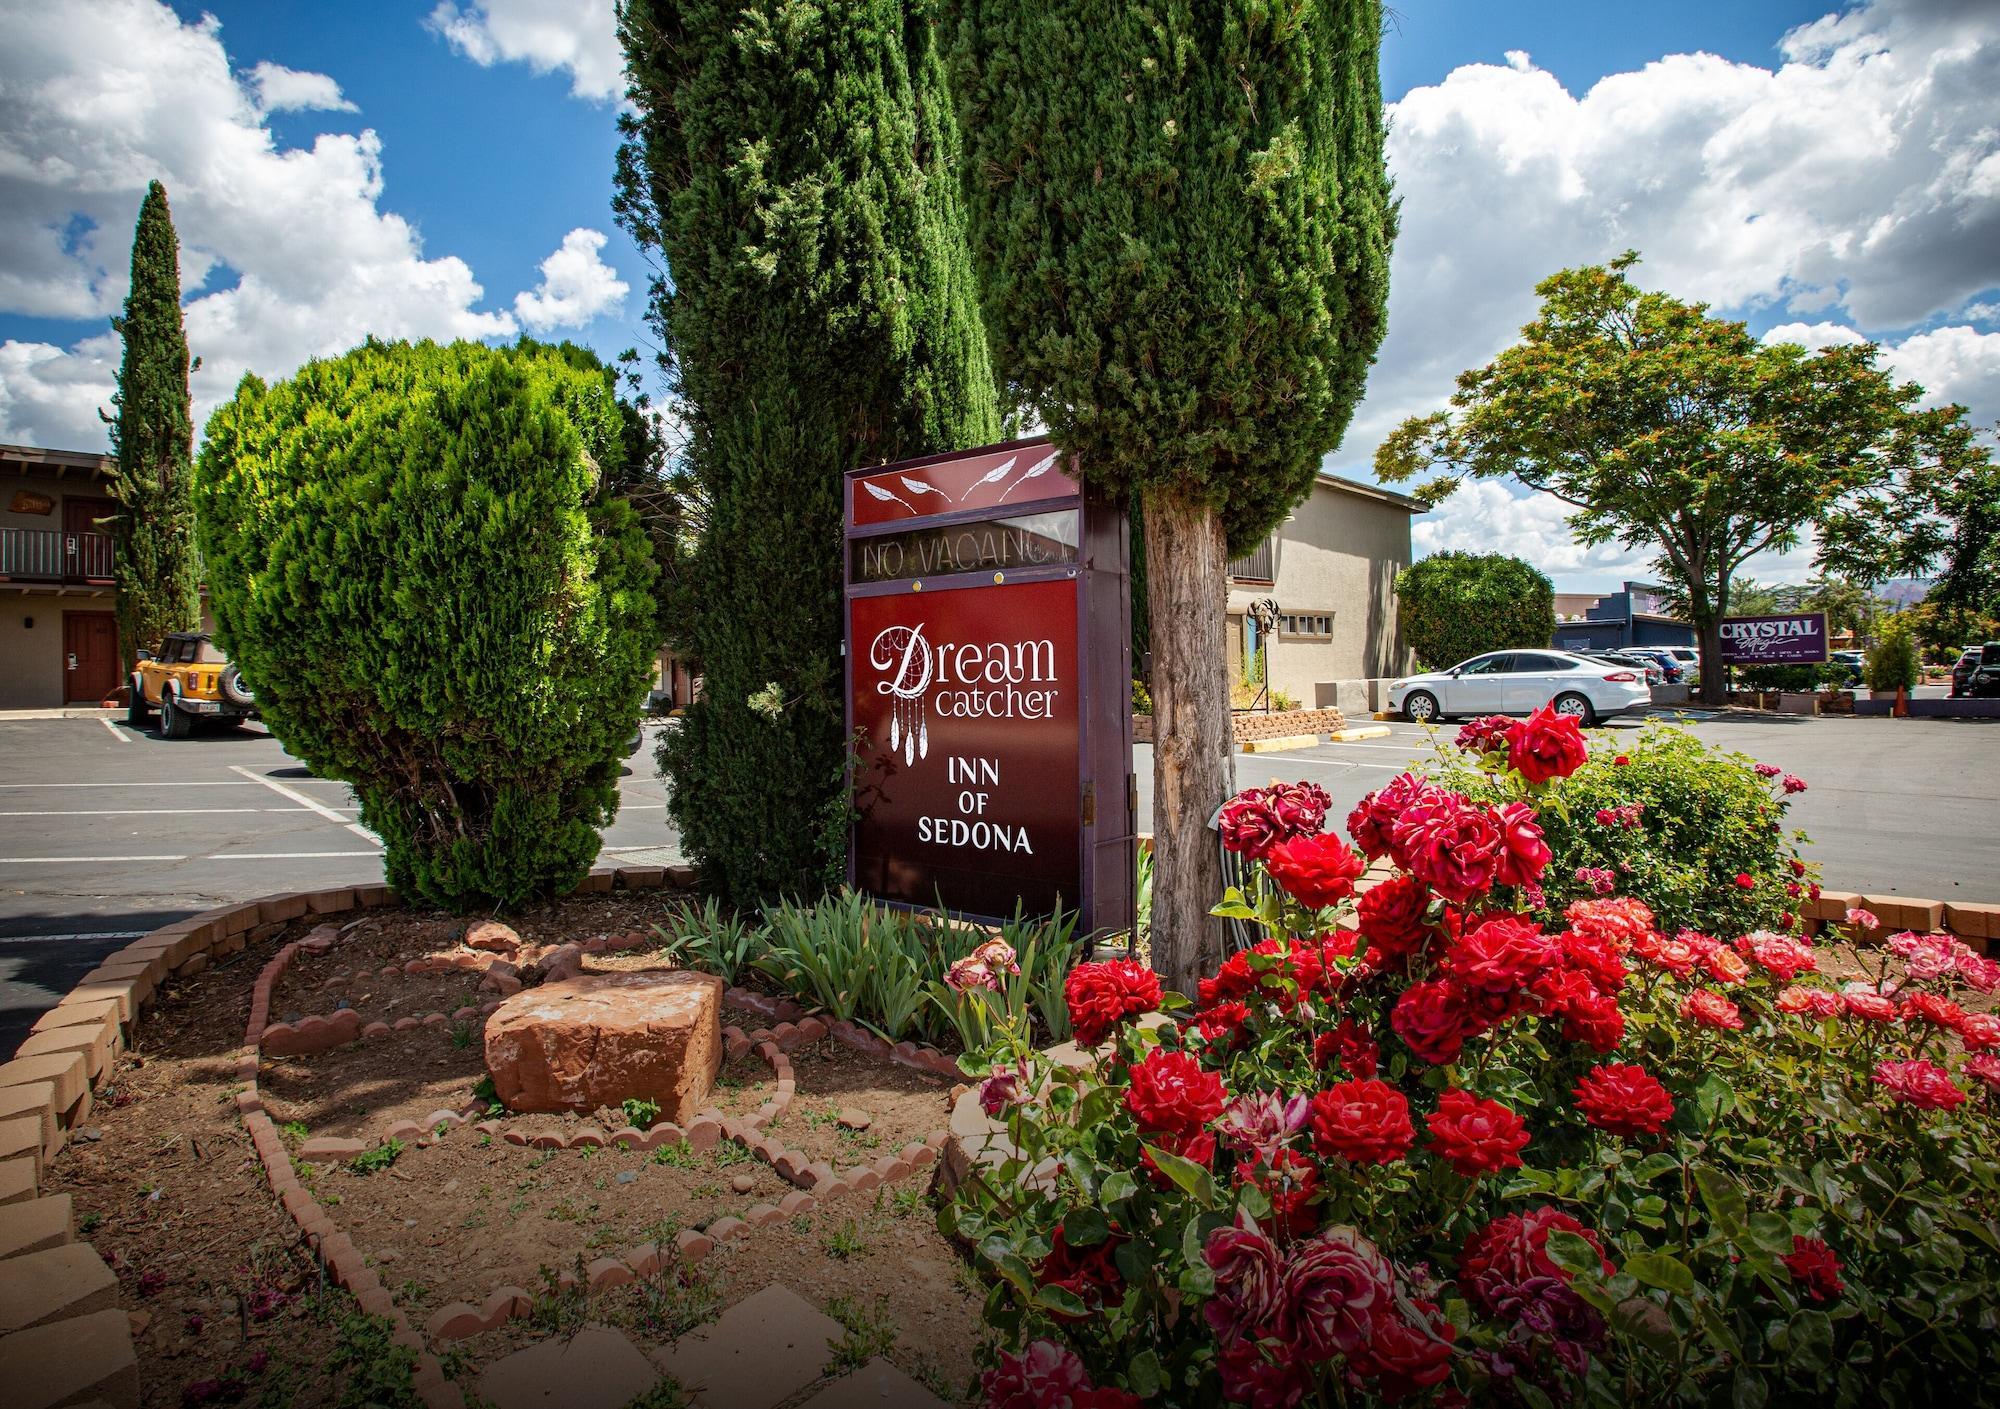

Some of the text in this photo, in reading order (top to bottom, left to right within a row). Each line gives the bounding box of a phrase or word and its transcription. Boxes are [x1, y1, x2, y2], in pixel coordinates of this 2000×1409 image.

[864, 521, 1072, 577] NO VACANCY
[1719, 619, 1820, 639] CRYSTAL
[1735, 635, 1799, 652] Magic
[870, 622, 1058, 699] Dream
[935, 682, 1059, 720] catcher
[947, 756, 1000, 786] INN
[958, 790, 989, 815] OF
[918, 816, 1034, 855] SEDONA
